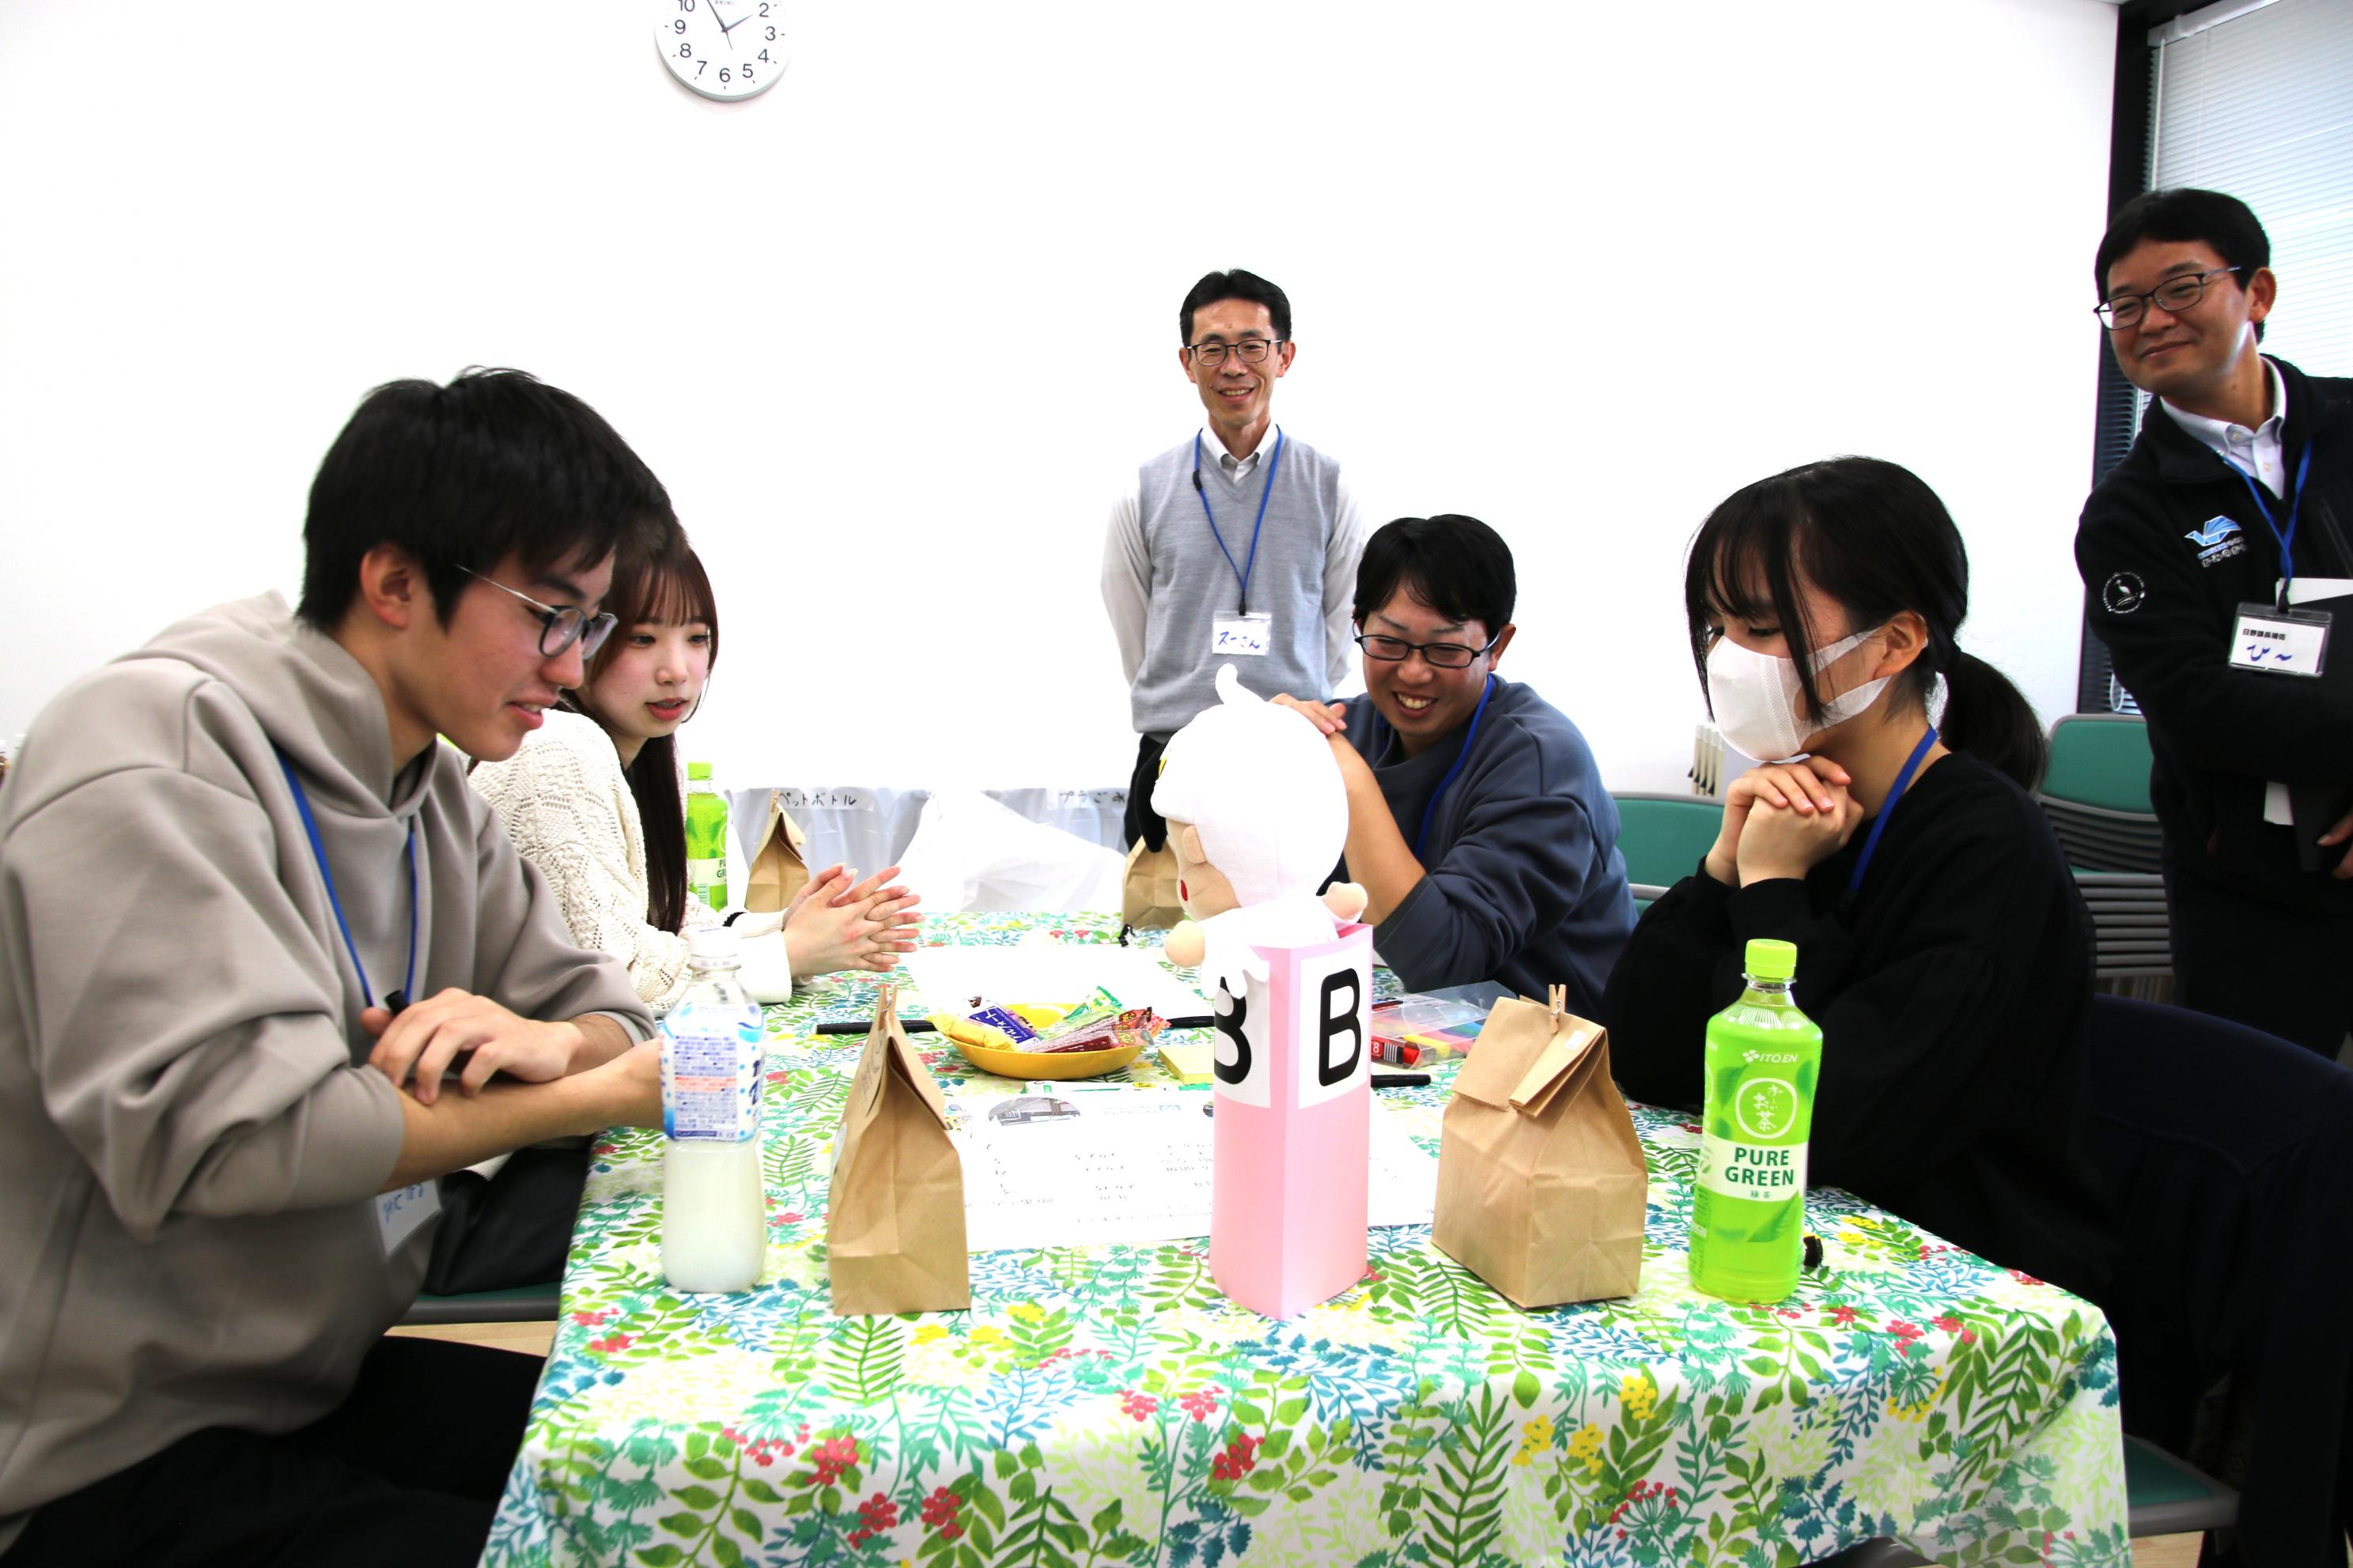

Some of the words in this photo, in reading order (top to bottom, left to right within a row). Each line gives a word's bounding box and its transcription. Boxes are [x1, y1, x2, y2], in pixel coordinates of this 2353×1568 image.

[679, 0, 695, 12] 10
[758, 2, 770, 17] 2
[674, 19, 687, 35] 9
[765, 26, 776, 41] 3
[679, 43, 692, 58] 8
[758, 48, 770, 63] 4
[697, 60, 707, 75] 7
[719, 67, 731, 82] 6
[742, 63, 754, 78] 5
[779, 792, 857, 806] ペットボトル
[1318, 968, 1361, 1087] B
[1372, 1042, 1379, 1053] 8
[1759, 1053, 1782, 1063] ITO
[1782, 1053, 1799, 1063] EN
[1734, 1147, 1789, 1166] PURE
[1725, 1166, 1794, 1186] GREEN
